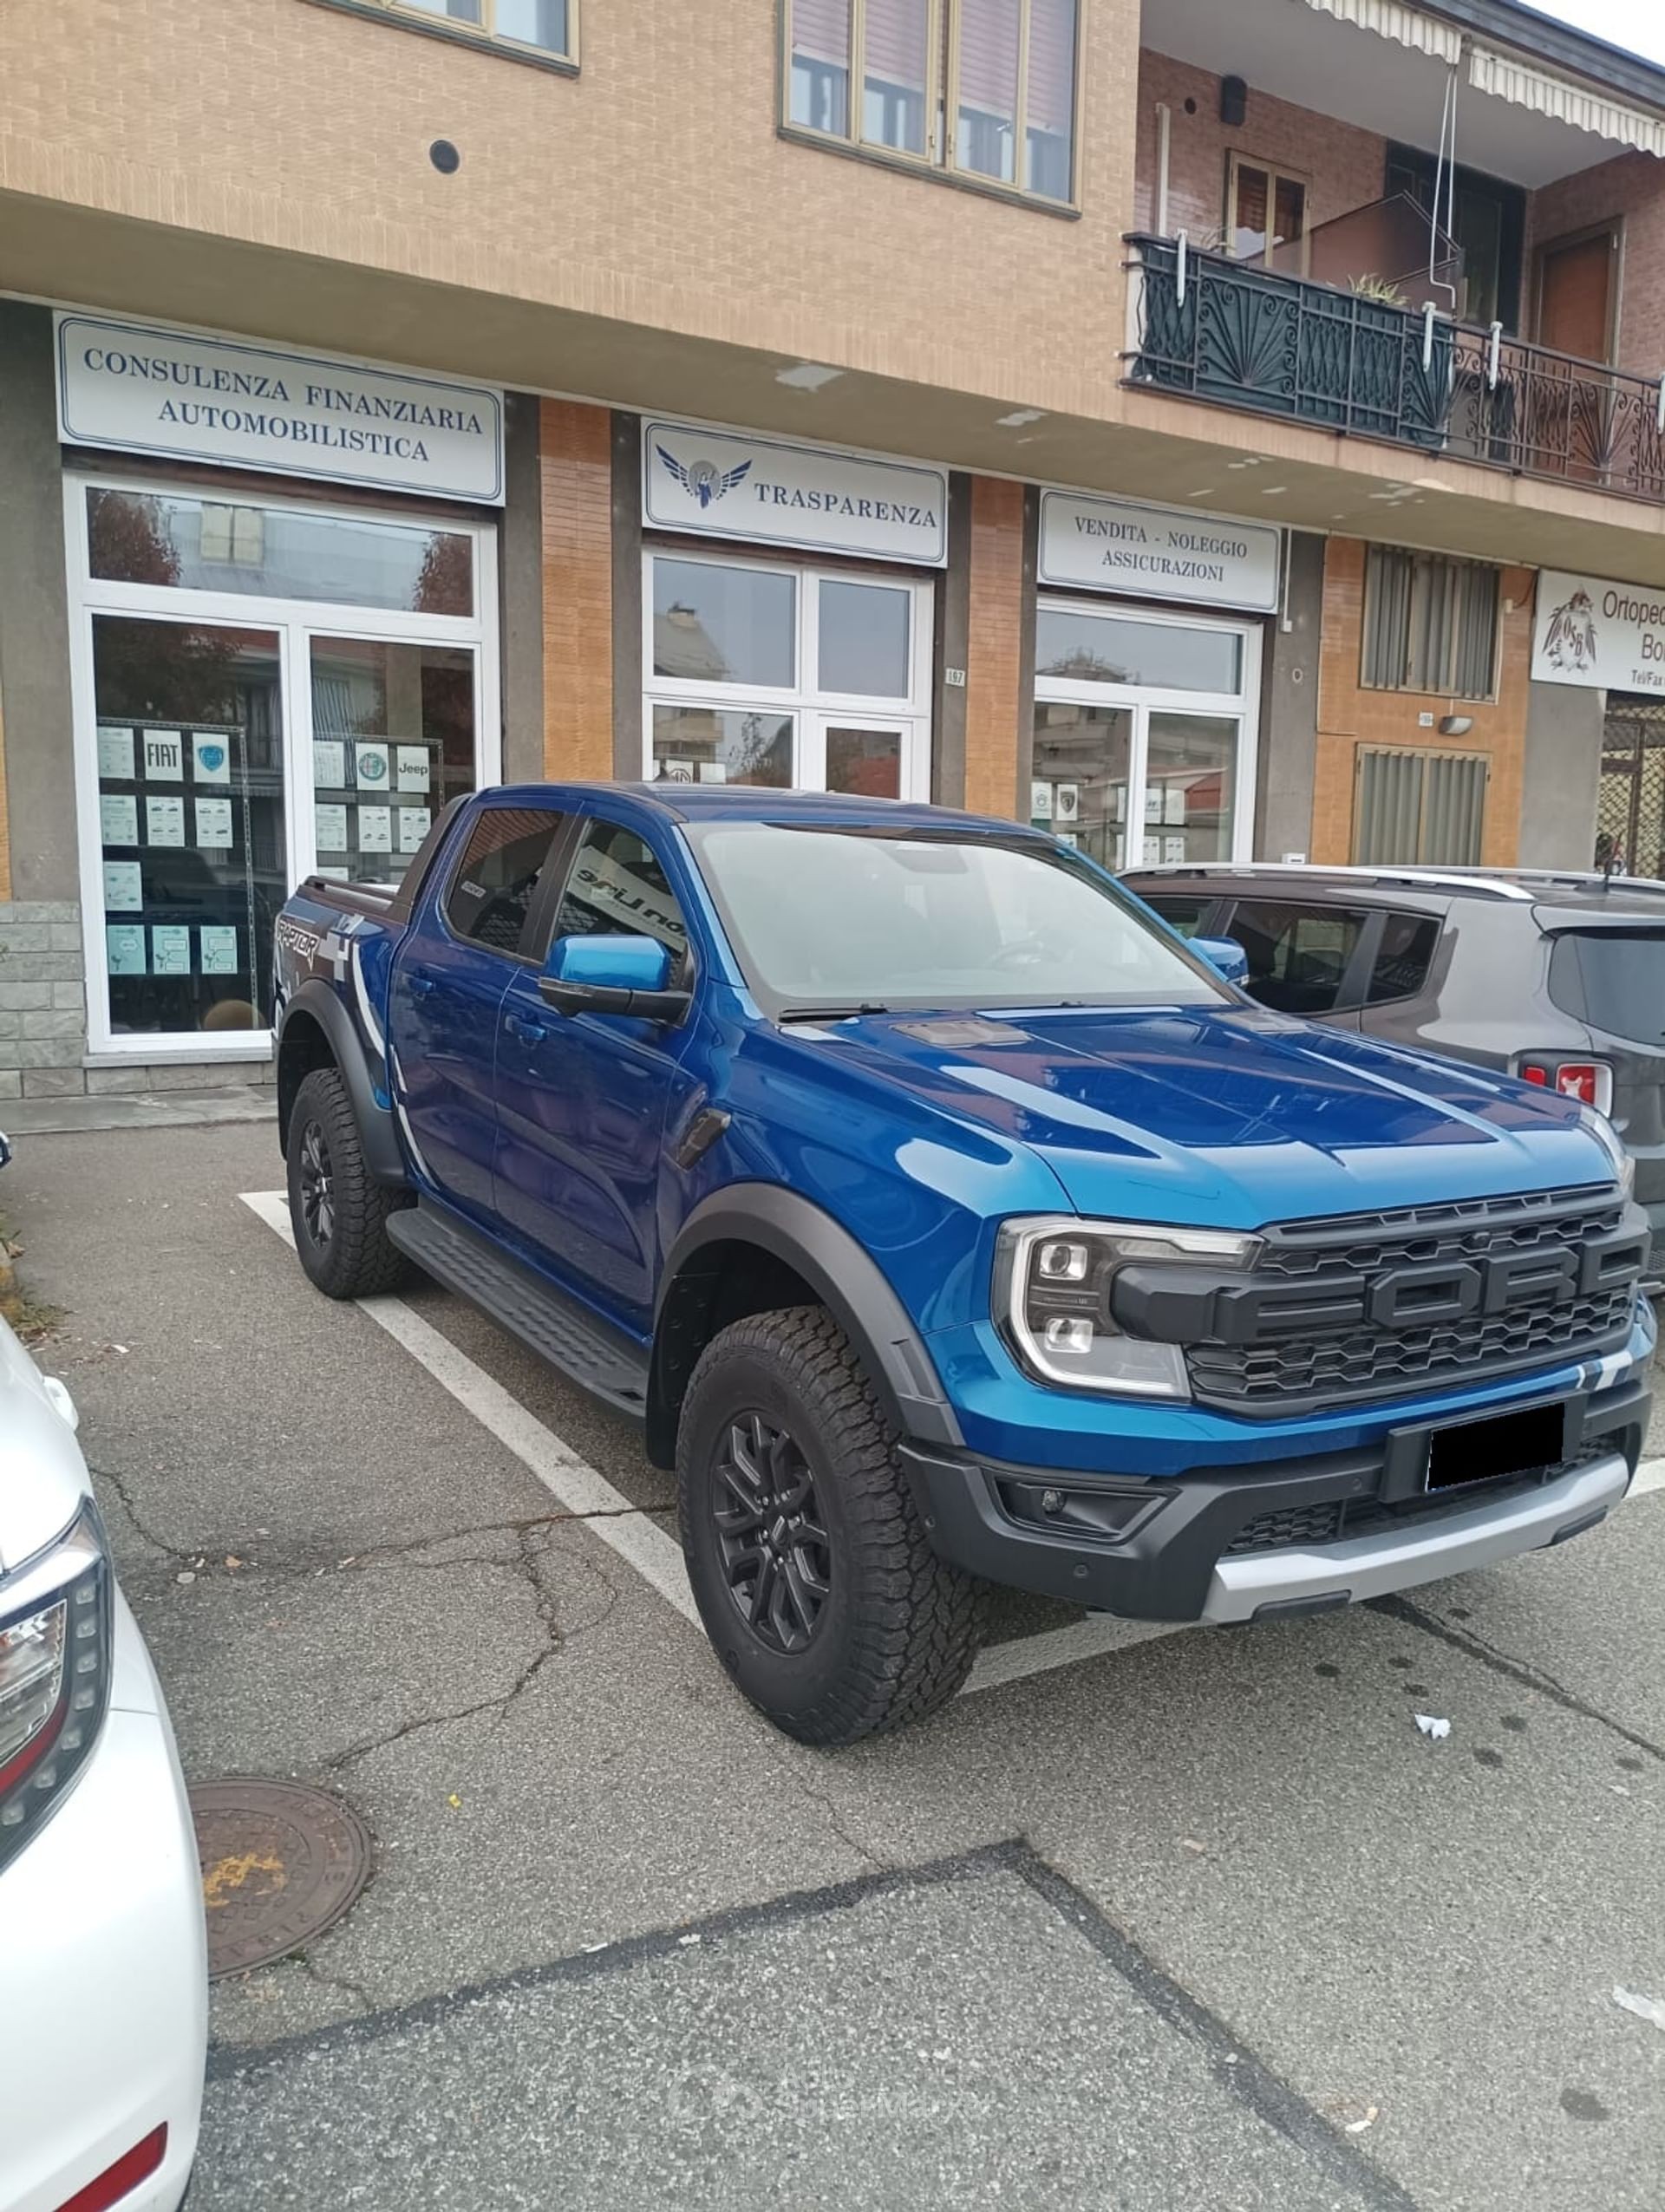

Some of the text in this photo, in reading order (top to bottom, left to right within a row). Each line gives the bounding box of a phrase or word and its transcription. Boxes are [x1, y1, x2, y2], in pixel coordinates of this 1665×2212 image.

[84, 348, 483, 434] CONSULENZA FINANZIARIA
[159, 400, 429, 462] AUTOMOBILISTICA
[754, 483, 937, 527] TRASPARENZA
[1074, 516, 1147, 543] VENDITA
[1168, 532, 1248, 558] NOLEGGIO
[1101, 550, 1224, 582] ASSICURAZIONI
[1642, 633, 1665, 662] Bo
[147, 743, 178, 767] FIAT
[399, 763, 428, 777] Jeep
[1214, 1233, 1649, 1344] FORD
